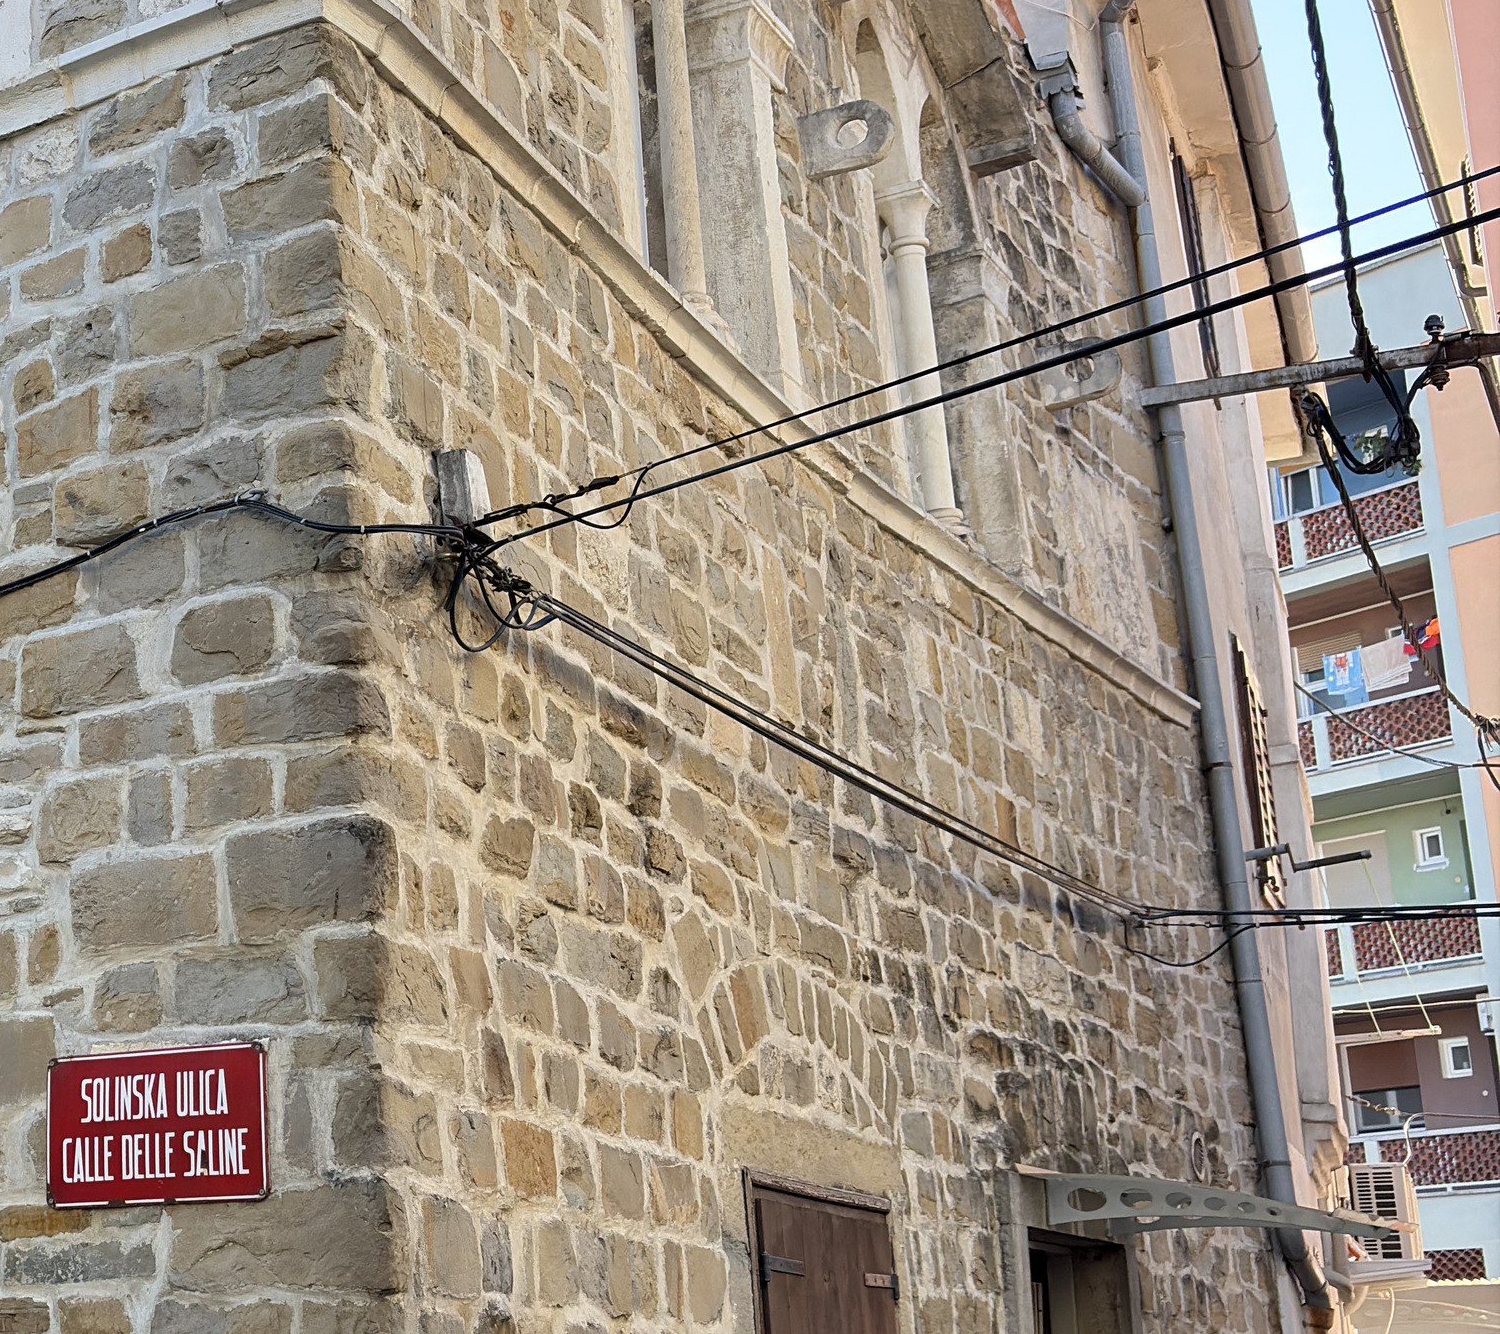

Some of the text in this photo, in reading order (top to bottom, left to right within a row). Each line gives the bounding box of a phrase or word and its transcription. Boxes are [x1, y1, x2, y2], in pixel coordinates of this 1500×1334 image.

[80, 1068, 229, 1123] SOLINSKA ULICA
[62, 1128, 250, 1184] CALLE DELLE SALINE
